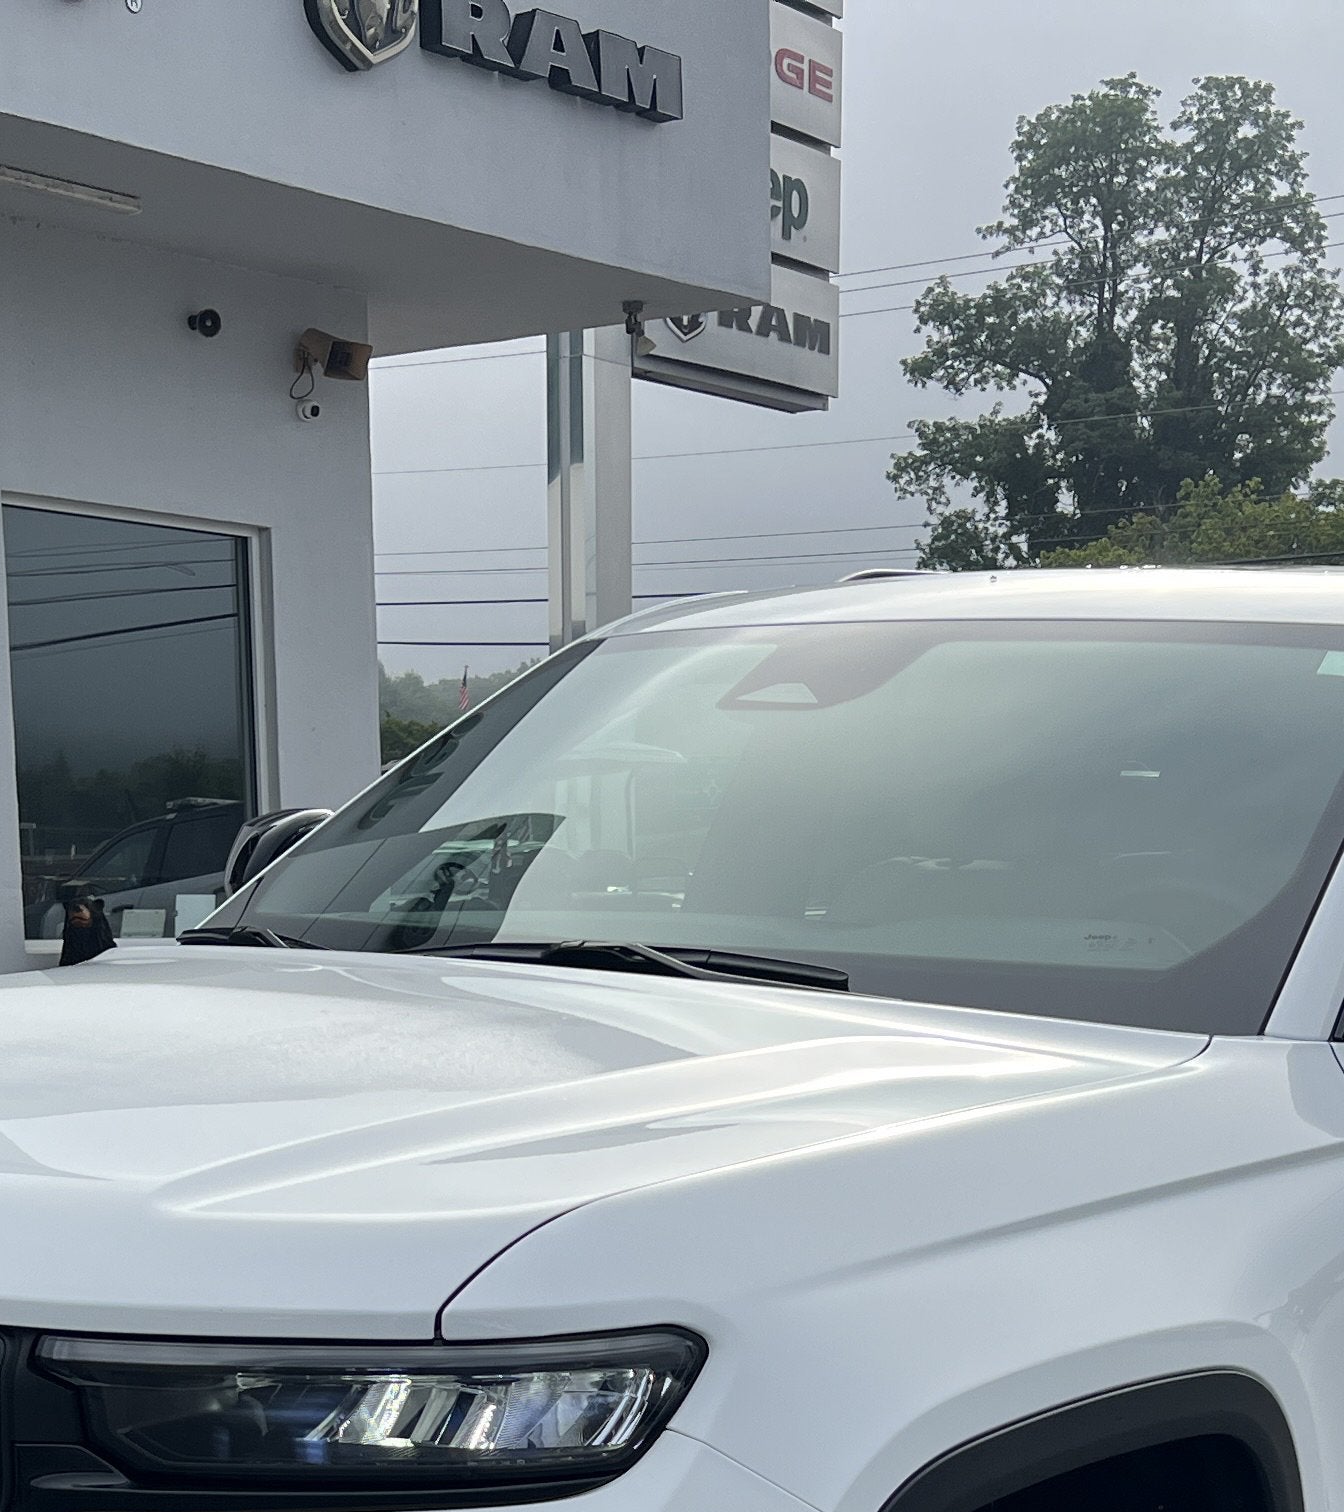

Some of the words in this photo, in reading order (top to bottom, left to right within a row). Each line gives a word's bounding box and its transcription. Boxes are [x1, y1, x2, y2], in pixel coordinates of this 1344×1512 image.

[421, 0, 683, 122] RAM
[774, 47, 834, 103] GE
[717, 303, 831, 356] RAM
